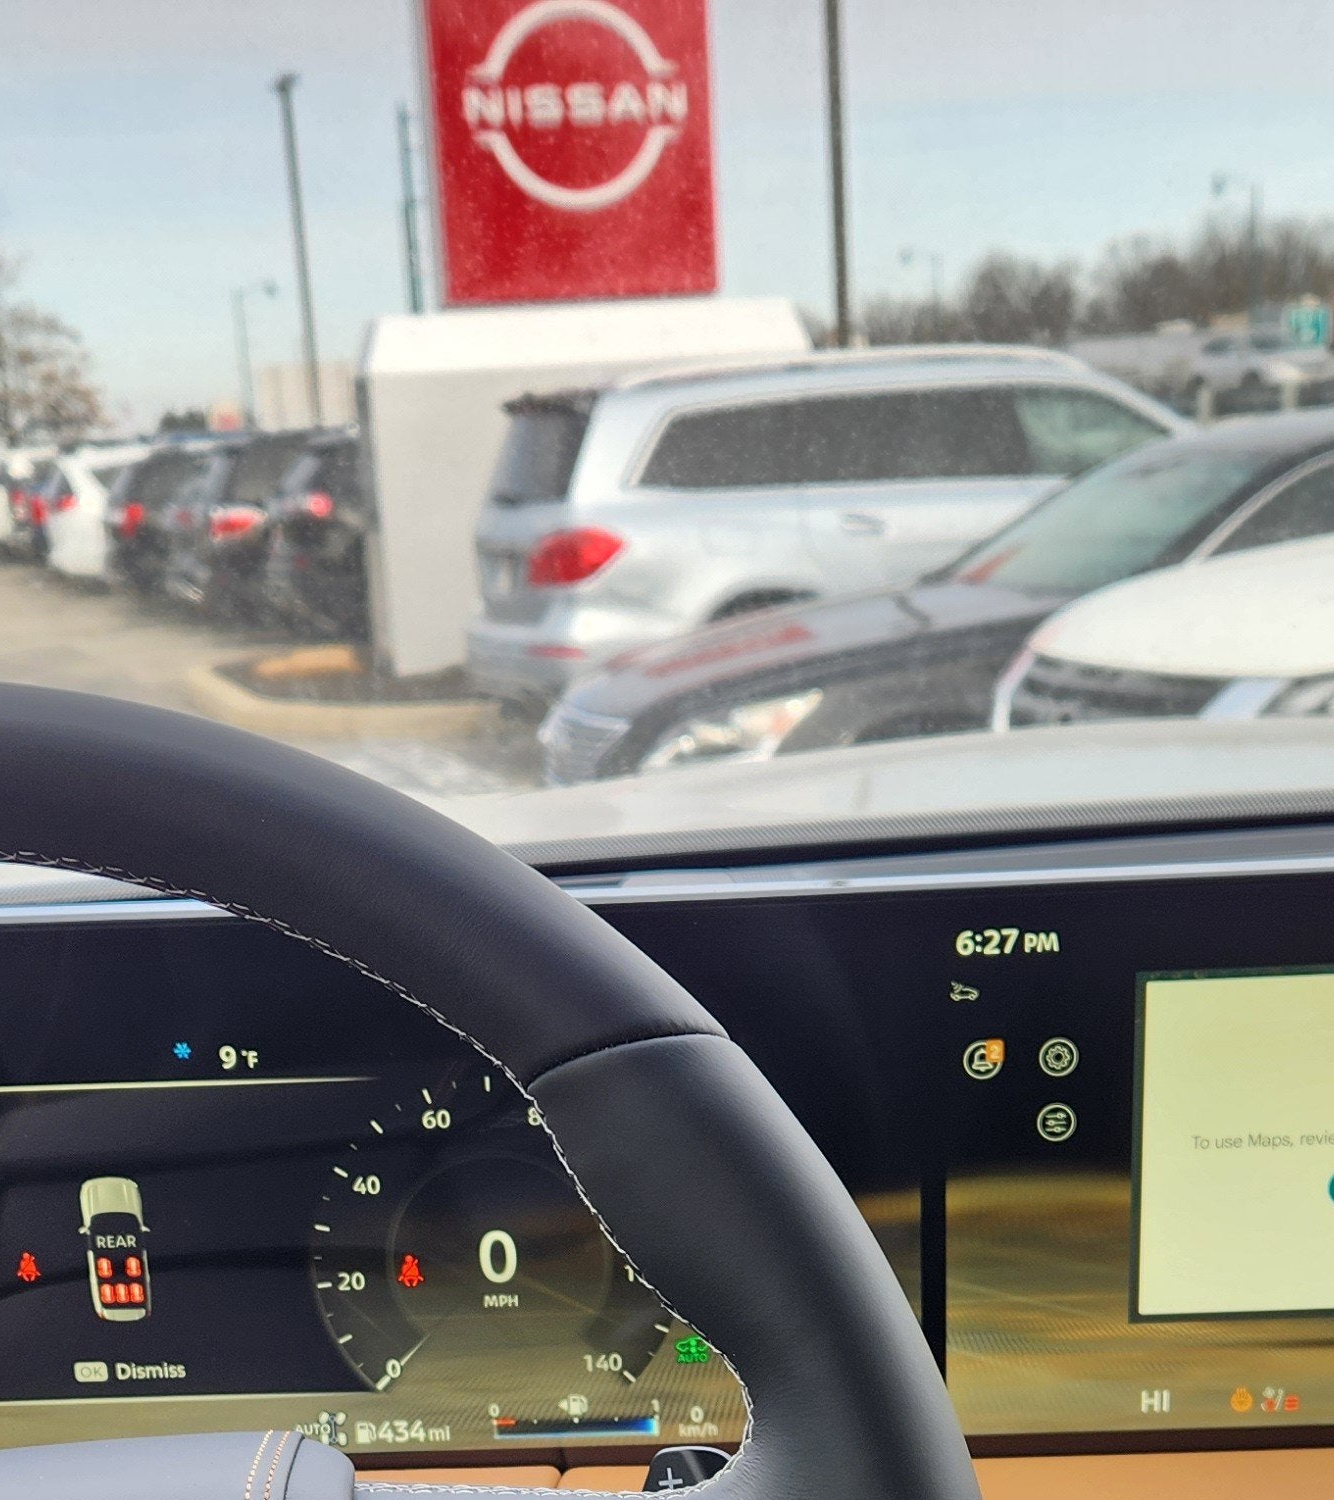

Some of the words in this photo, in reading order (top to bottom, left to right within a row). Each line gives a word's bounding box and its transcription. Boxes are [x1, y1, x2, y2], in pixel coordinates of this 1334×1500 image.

[462, 82, 688, 130] NISSAN
[956, 928, 1019, 956] 6:27
[1024, 932, 1060, 953] PM
[219, 1045, 237, 1070] 9
[421, 1110, 451, 1131] 60
[527, 1107, 544, 1126] 8
[1191, 1135, 1210, 1150] To
[1214, 1138, 1243, 1150] use
[1248, 1132, 1294, 1149] Maps,
[353, 1175, 382, 1196] 40
[96, 1234, 137, 1249] REAR
[478, 1230, 518, 1284] 0
[338, 1272, 366, 1292] 20
[483, 1294, 519, 1308] MPH
[385, 1359, 402, 1378] 0
[584, 1353, 622, 1372] 140
[677, 1353, 709, 1365] AUTO
[80, 1365, 104, 1379] OK
[115, 1362, 187, 1381] Dismiss
[489, 1403, 500, 1417] 0
[1141, 1389, 1171, 1413] HI
[690, 1405, 704, 1423] 0
[376, 1420, 427, 1443] 434
[428, 1424, 451, 1442] mi
[679, 1422, 719, 1437] km/h
